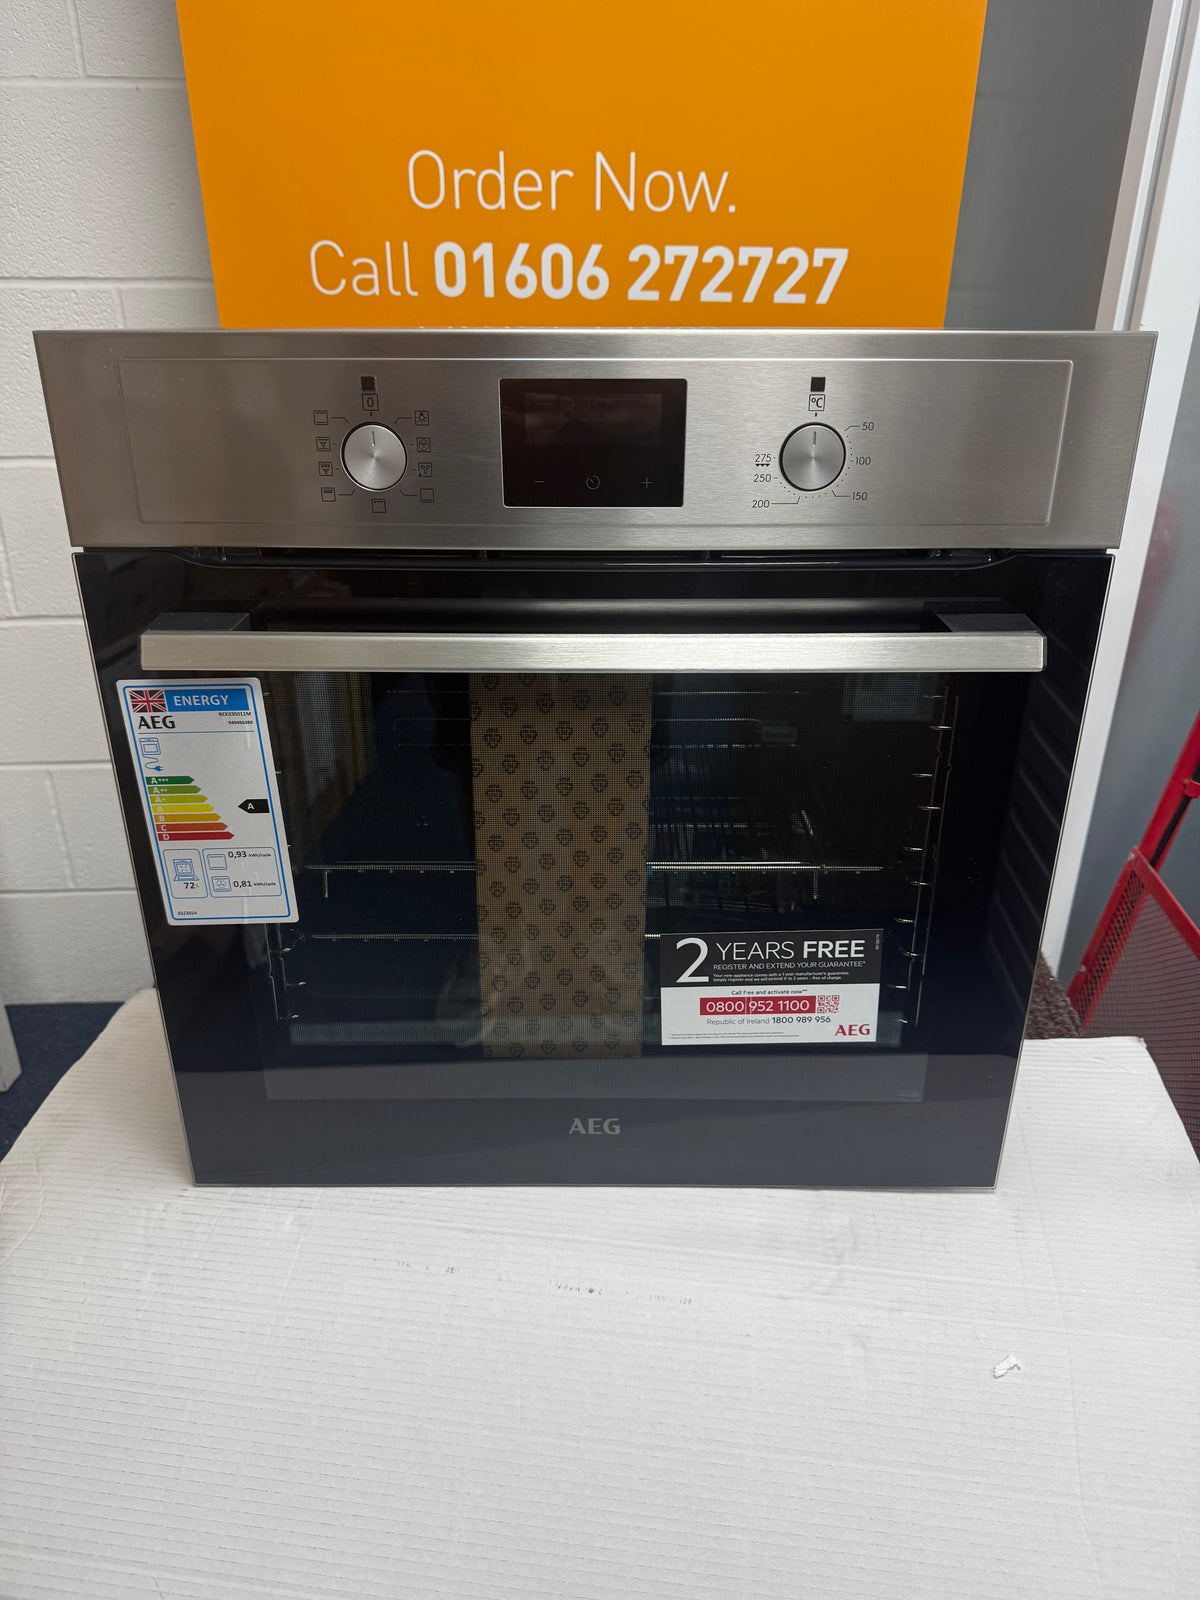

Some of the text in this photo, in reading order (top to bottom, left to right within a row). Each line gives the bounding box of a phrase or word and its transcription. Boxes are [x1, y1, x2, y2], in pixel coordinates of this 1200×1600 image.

[407, 149, 736, 213] Order Now.
[310, 239, 849, 304] Call 01606 272727
[861, 421, 875, 431] 50
[754, 453, 772, 463] 275
[855, 456, 872, 466] 100
[753, 473, 772, 483] 250
[851, 491, 868, 501] 150
[751, 499, 770, 509] 200
[173, 694, 229, 706] ENERGY
[138, 715, 176, 730] AEG
[247, 802, 255, 810] A
[160, 824, 167, 832] C
[162, 833, 170, 841] D
[227, 850, 247, 859] 0,93
[233, 880, 253, 889] 0,81
[675, 936, 710, 983] 2
[715, 941, 795, 961] YEARS
[802, 939, 866, 959] FREE
[706, 1000, 810, 1013] 0800 952 1100
[706, 1015, 831, 1026] Republic of Ireland 1800 989 956
[834, 1023, 871, 1036] AEG
[568, 1117, 621, 1136] AEG
